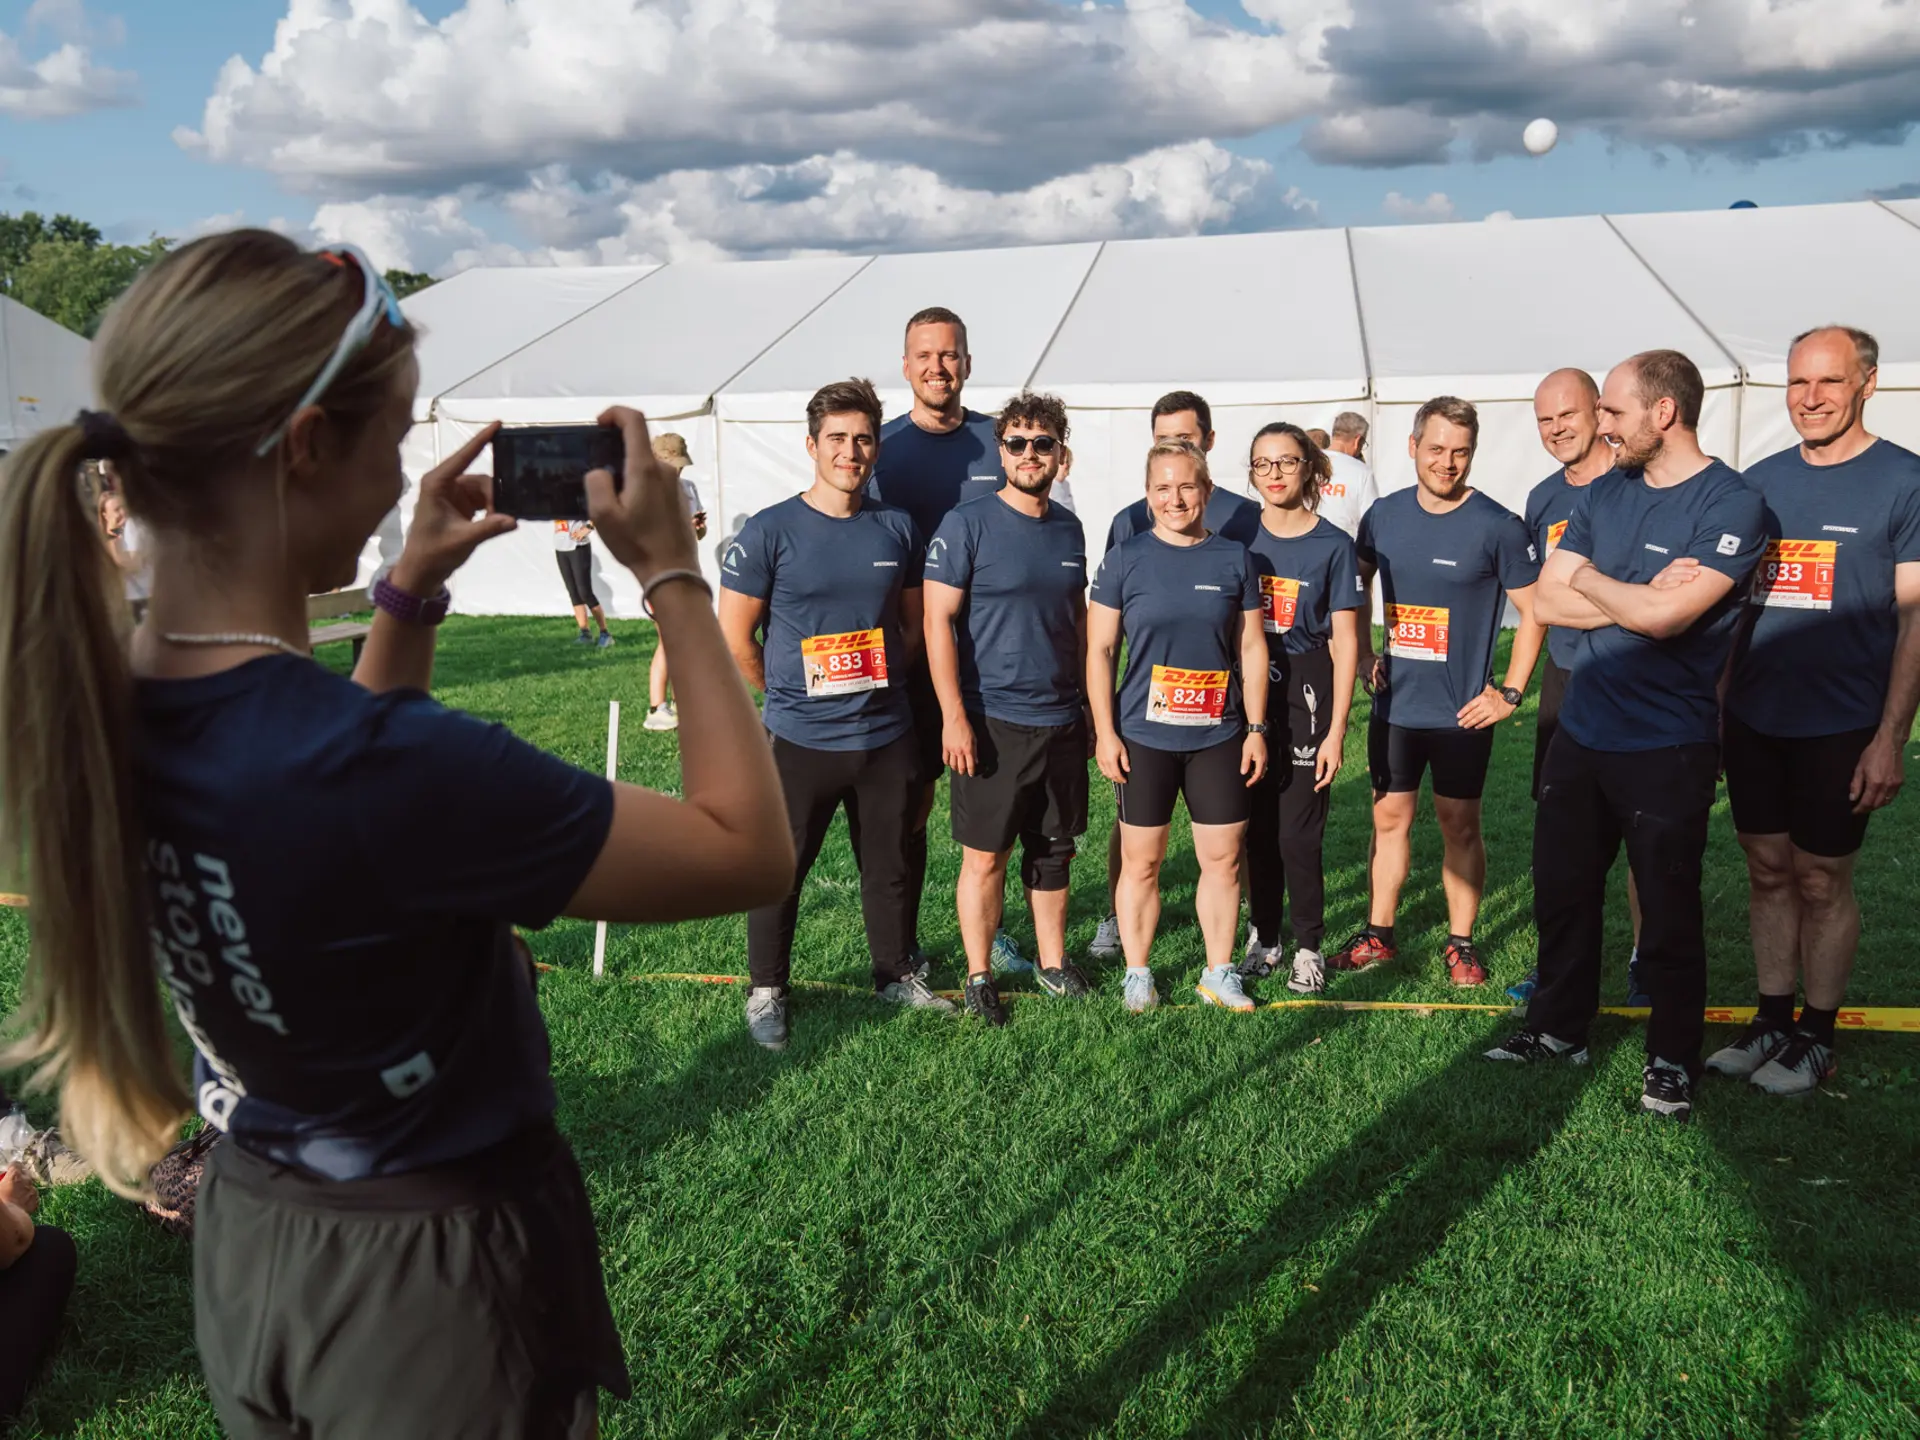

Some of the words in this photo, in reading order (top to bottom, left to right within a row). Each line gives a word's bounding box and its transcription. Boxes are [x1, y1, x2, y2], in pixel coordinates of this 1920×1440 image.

[1320, 483, 1345, 497] RA
[1763, 542, 1821, 558] DHL
[1766, 562, 1804, 582] 833
[1820, 569, 1828, 582] 1
[1285, 602, 1293, 613] 5
[1391, 605, 1438, 621] DHL
[1399, 622, 1426, 640] 833
[1437, 630, 1445, 640] 3
[813, 632, 873, 652] DHL
[829, 652, 863, 672] 833
[874, 653, 883, 665] 2
[1163, 669, 1218, 685] DHL
[1173, 688, 1206, 705] 824
[1215, 693, 1223, 703] 3
[1292, 759, 1315, 767] adidas
[148, 838, 214, 986] stop
[193, 852, 290, 1036] never
